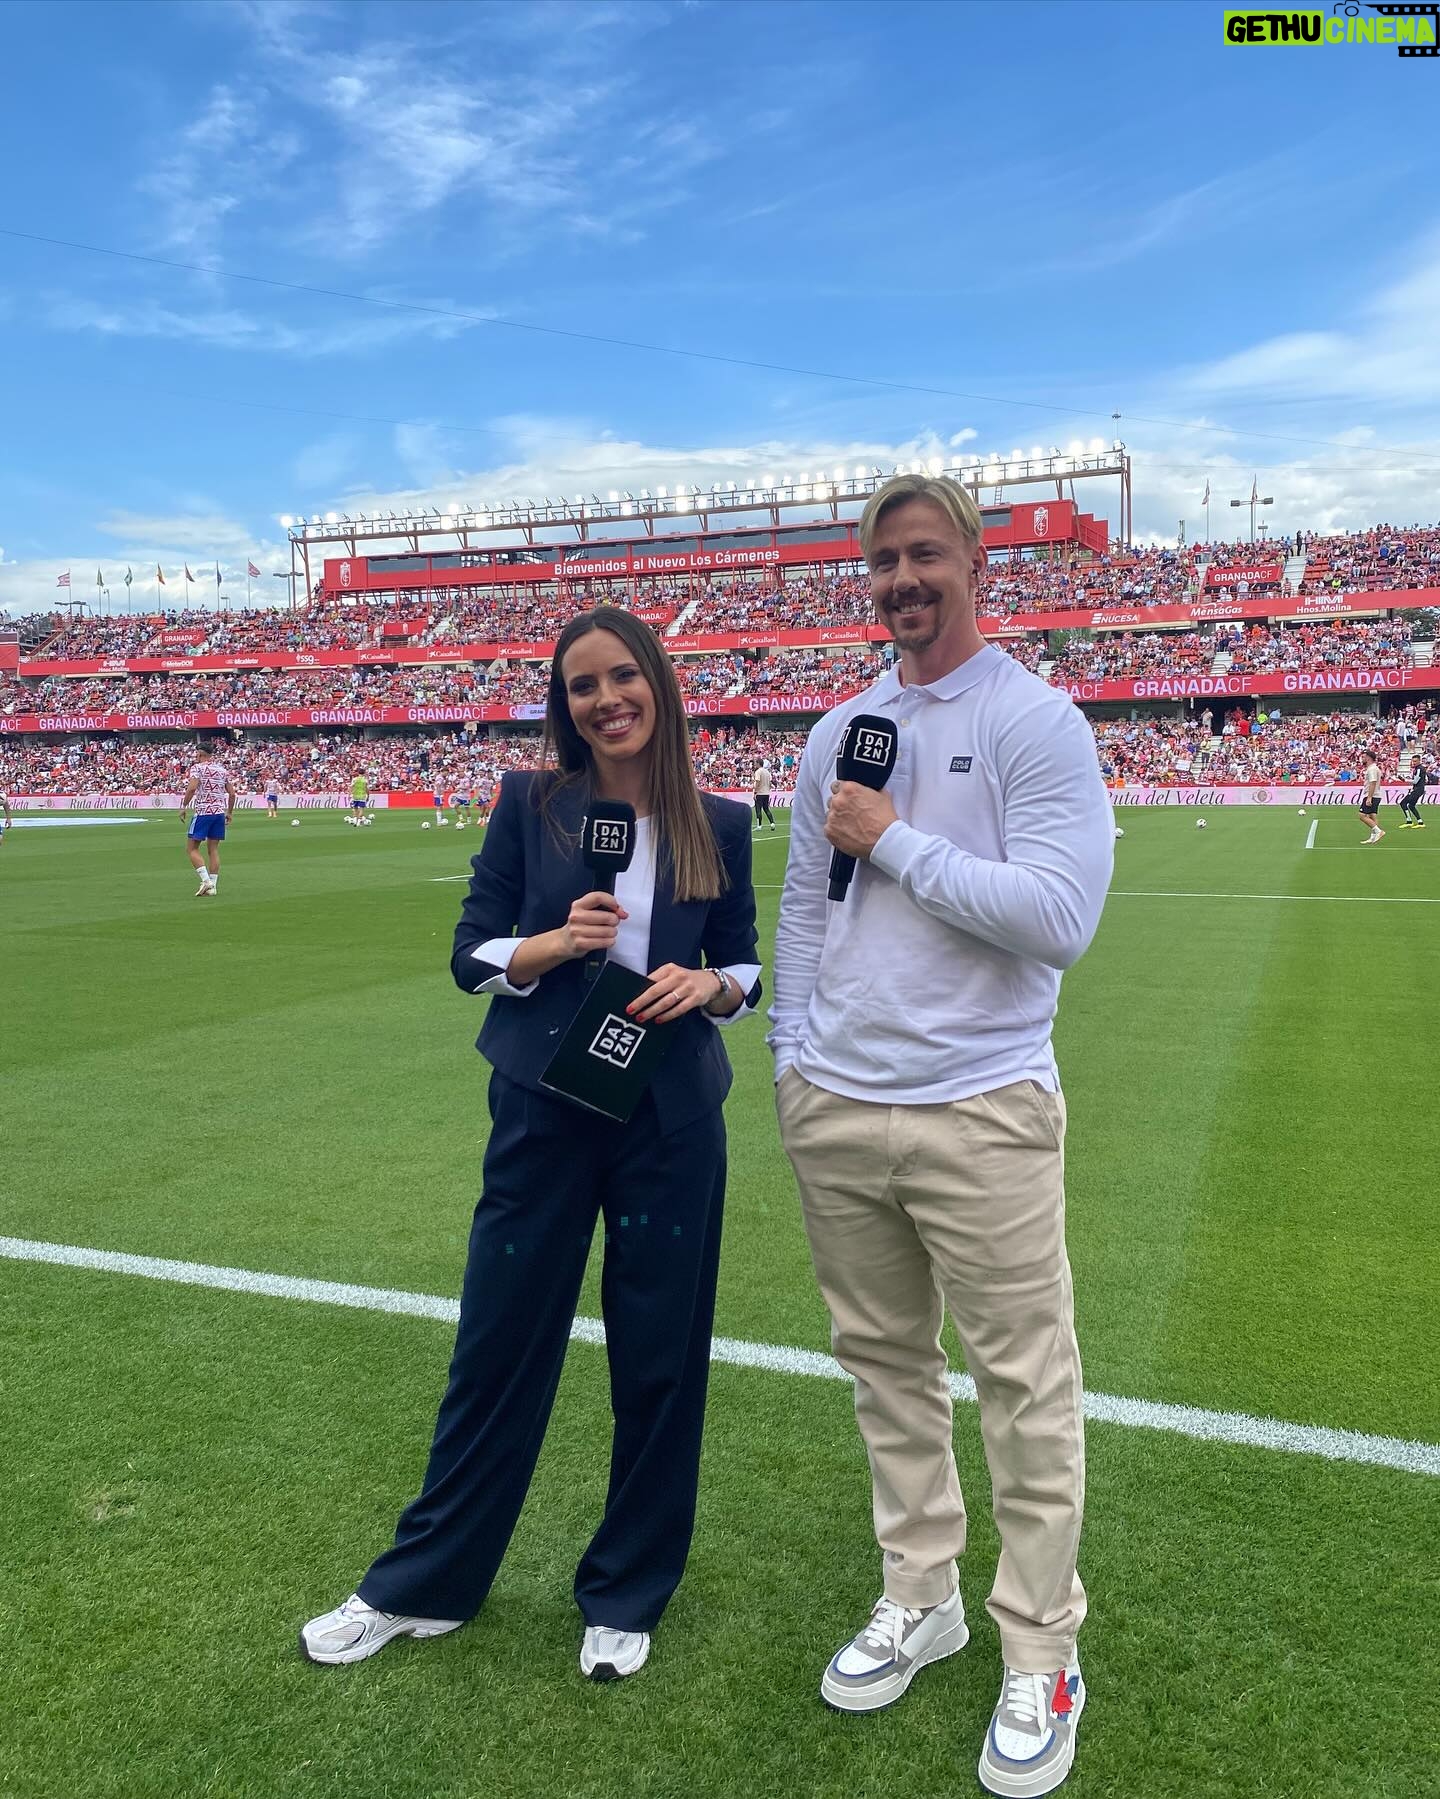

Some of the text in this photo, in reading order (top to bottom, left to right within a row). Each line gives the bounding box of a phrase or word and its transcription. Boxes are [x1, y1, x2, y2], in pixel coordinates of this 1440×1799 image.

[554, 550, 780, 575] Bienvenidos al Nuevo Los Cármenes
[998, 624, 1024, 632] Halcón
[748, 636, 777, 644] CaixaBank
[296, 797, 321, 808] Ruta
[324, 796, 340, 808] del
[1109, 789, 1225, 805] uta del Veleta
[1302, 790, 1345, 805] Ruta
[1385, 789, 1438, 805] Veta
[10, 799, 29, 809] eleta
[70, 798, 138, 809] Ruta del Veleta
